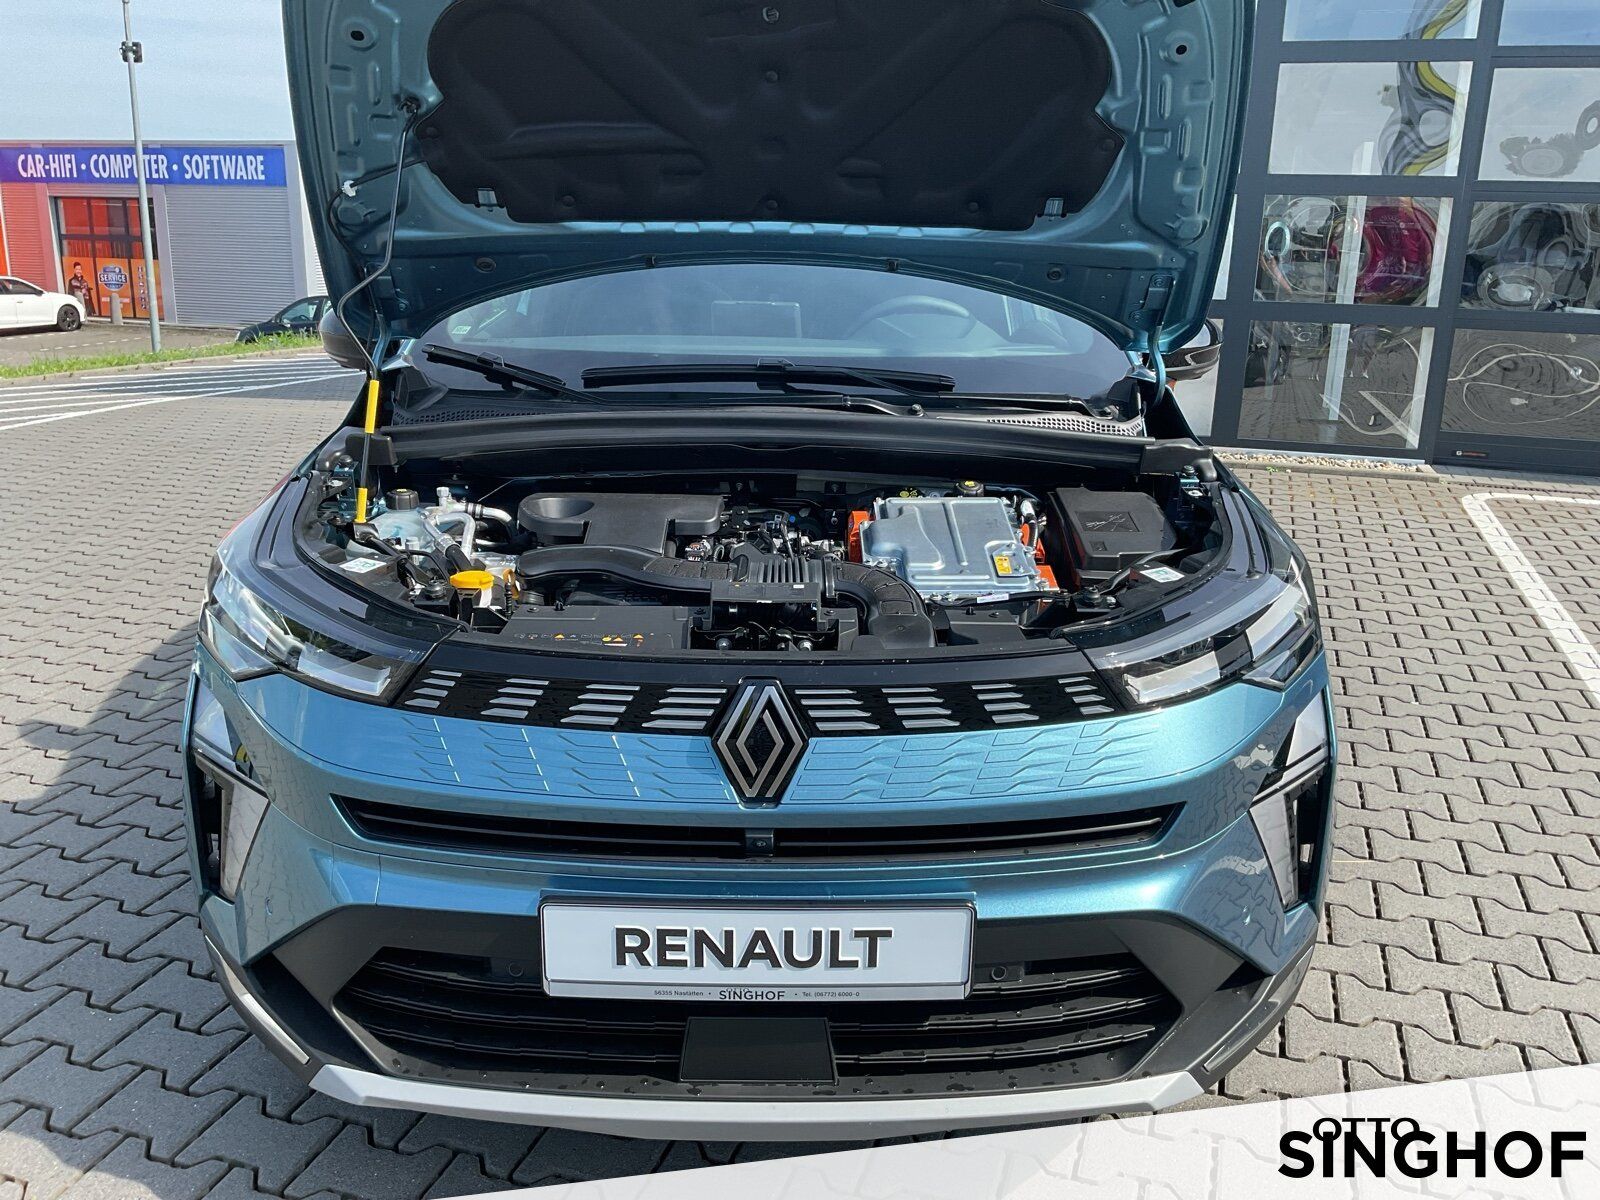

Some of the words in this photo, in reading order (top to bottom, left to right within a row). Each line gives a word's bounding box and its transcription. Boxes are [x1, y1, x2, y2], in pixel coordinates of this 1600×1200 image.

[17, 153, 77, 178] CAR-HIFI
[183, 155, 265, 180] SOFTWARE
[99, 273, 127, 282] SERVICE
[614, 926, 893, 969] RENAULT
[719, 990, 785, 1000] SINGHOF
